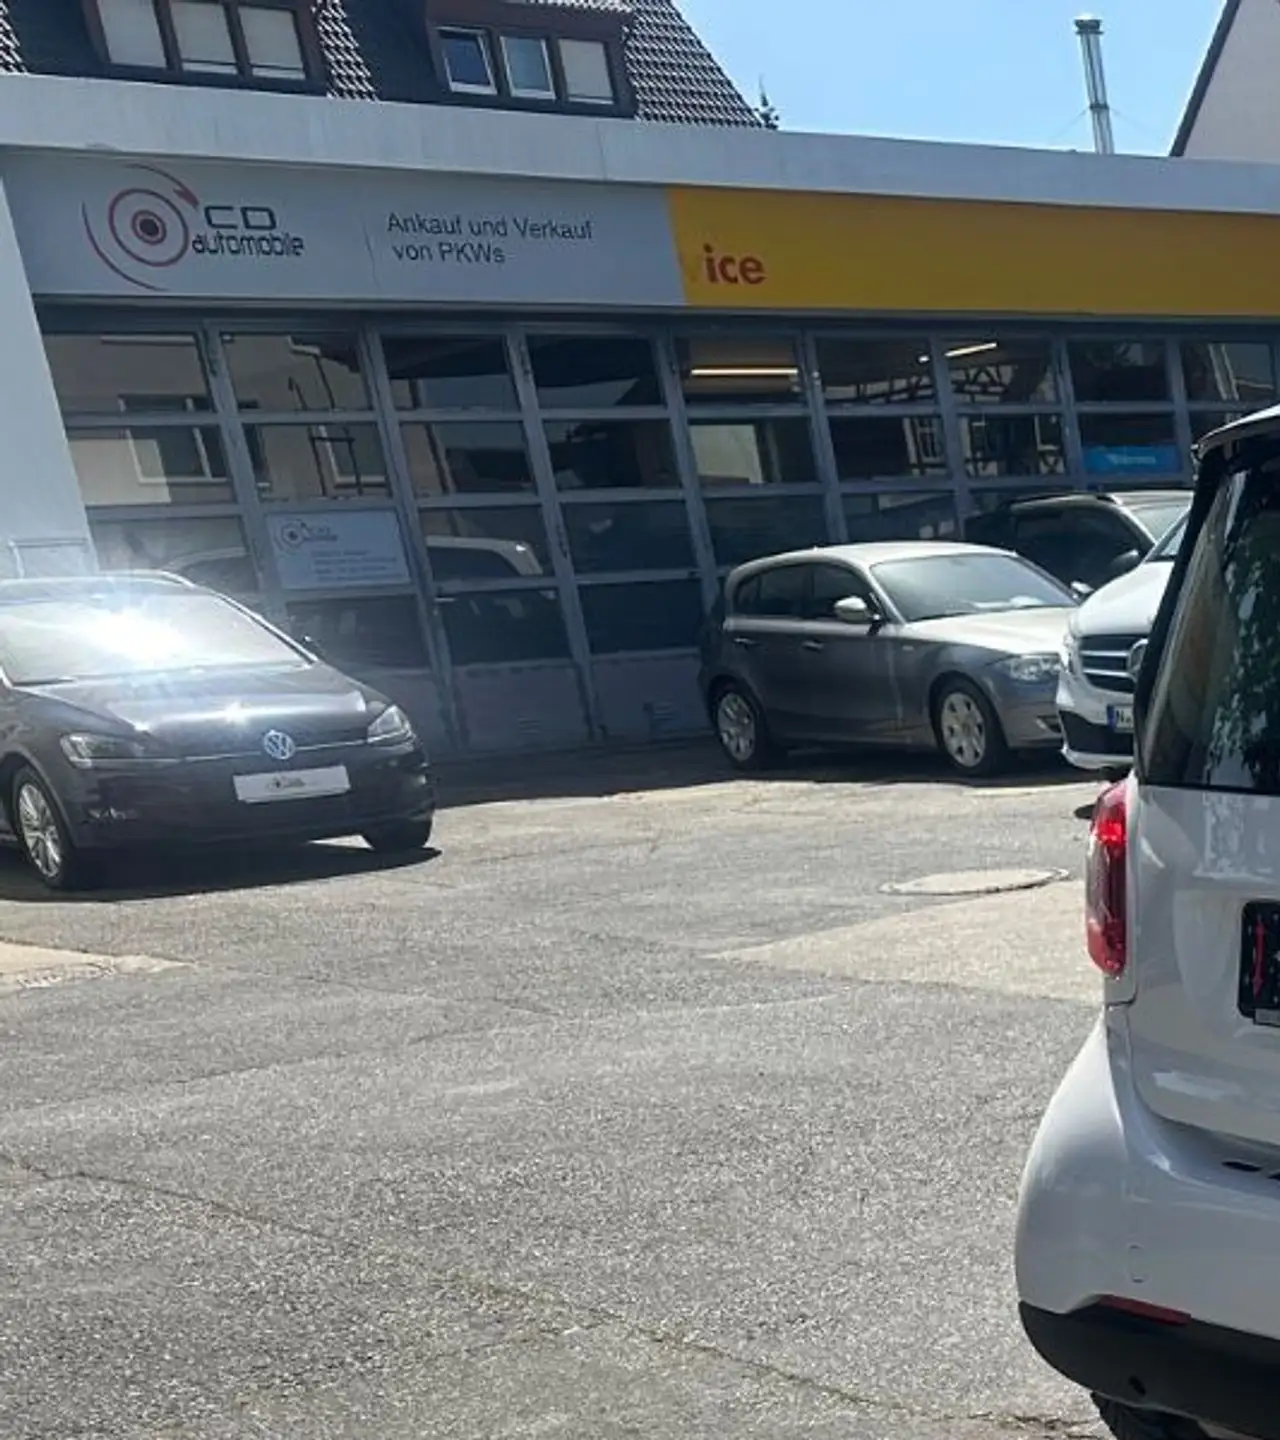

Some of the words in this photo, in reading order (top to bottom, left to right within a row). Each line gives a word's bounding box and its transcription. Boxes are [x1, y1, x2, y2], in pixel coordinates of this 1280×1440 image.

[204, 206, 277, 229] CD
[387, 212, 462, 236] Ankauf
[468, 214, 508, 236] und
[513, 216, 594, 240] Verkauf
[191, 230, 304, 257] automobile
[391, 244, 433, 261] von
[438, 242, 506, 263] PKWs
